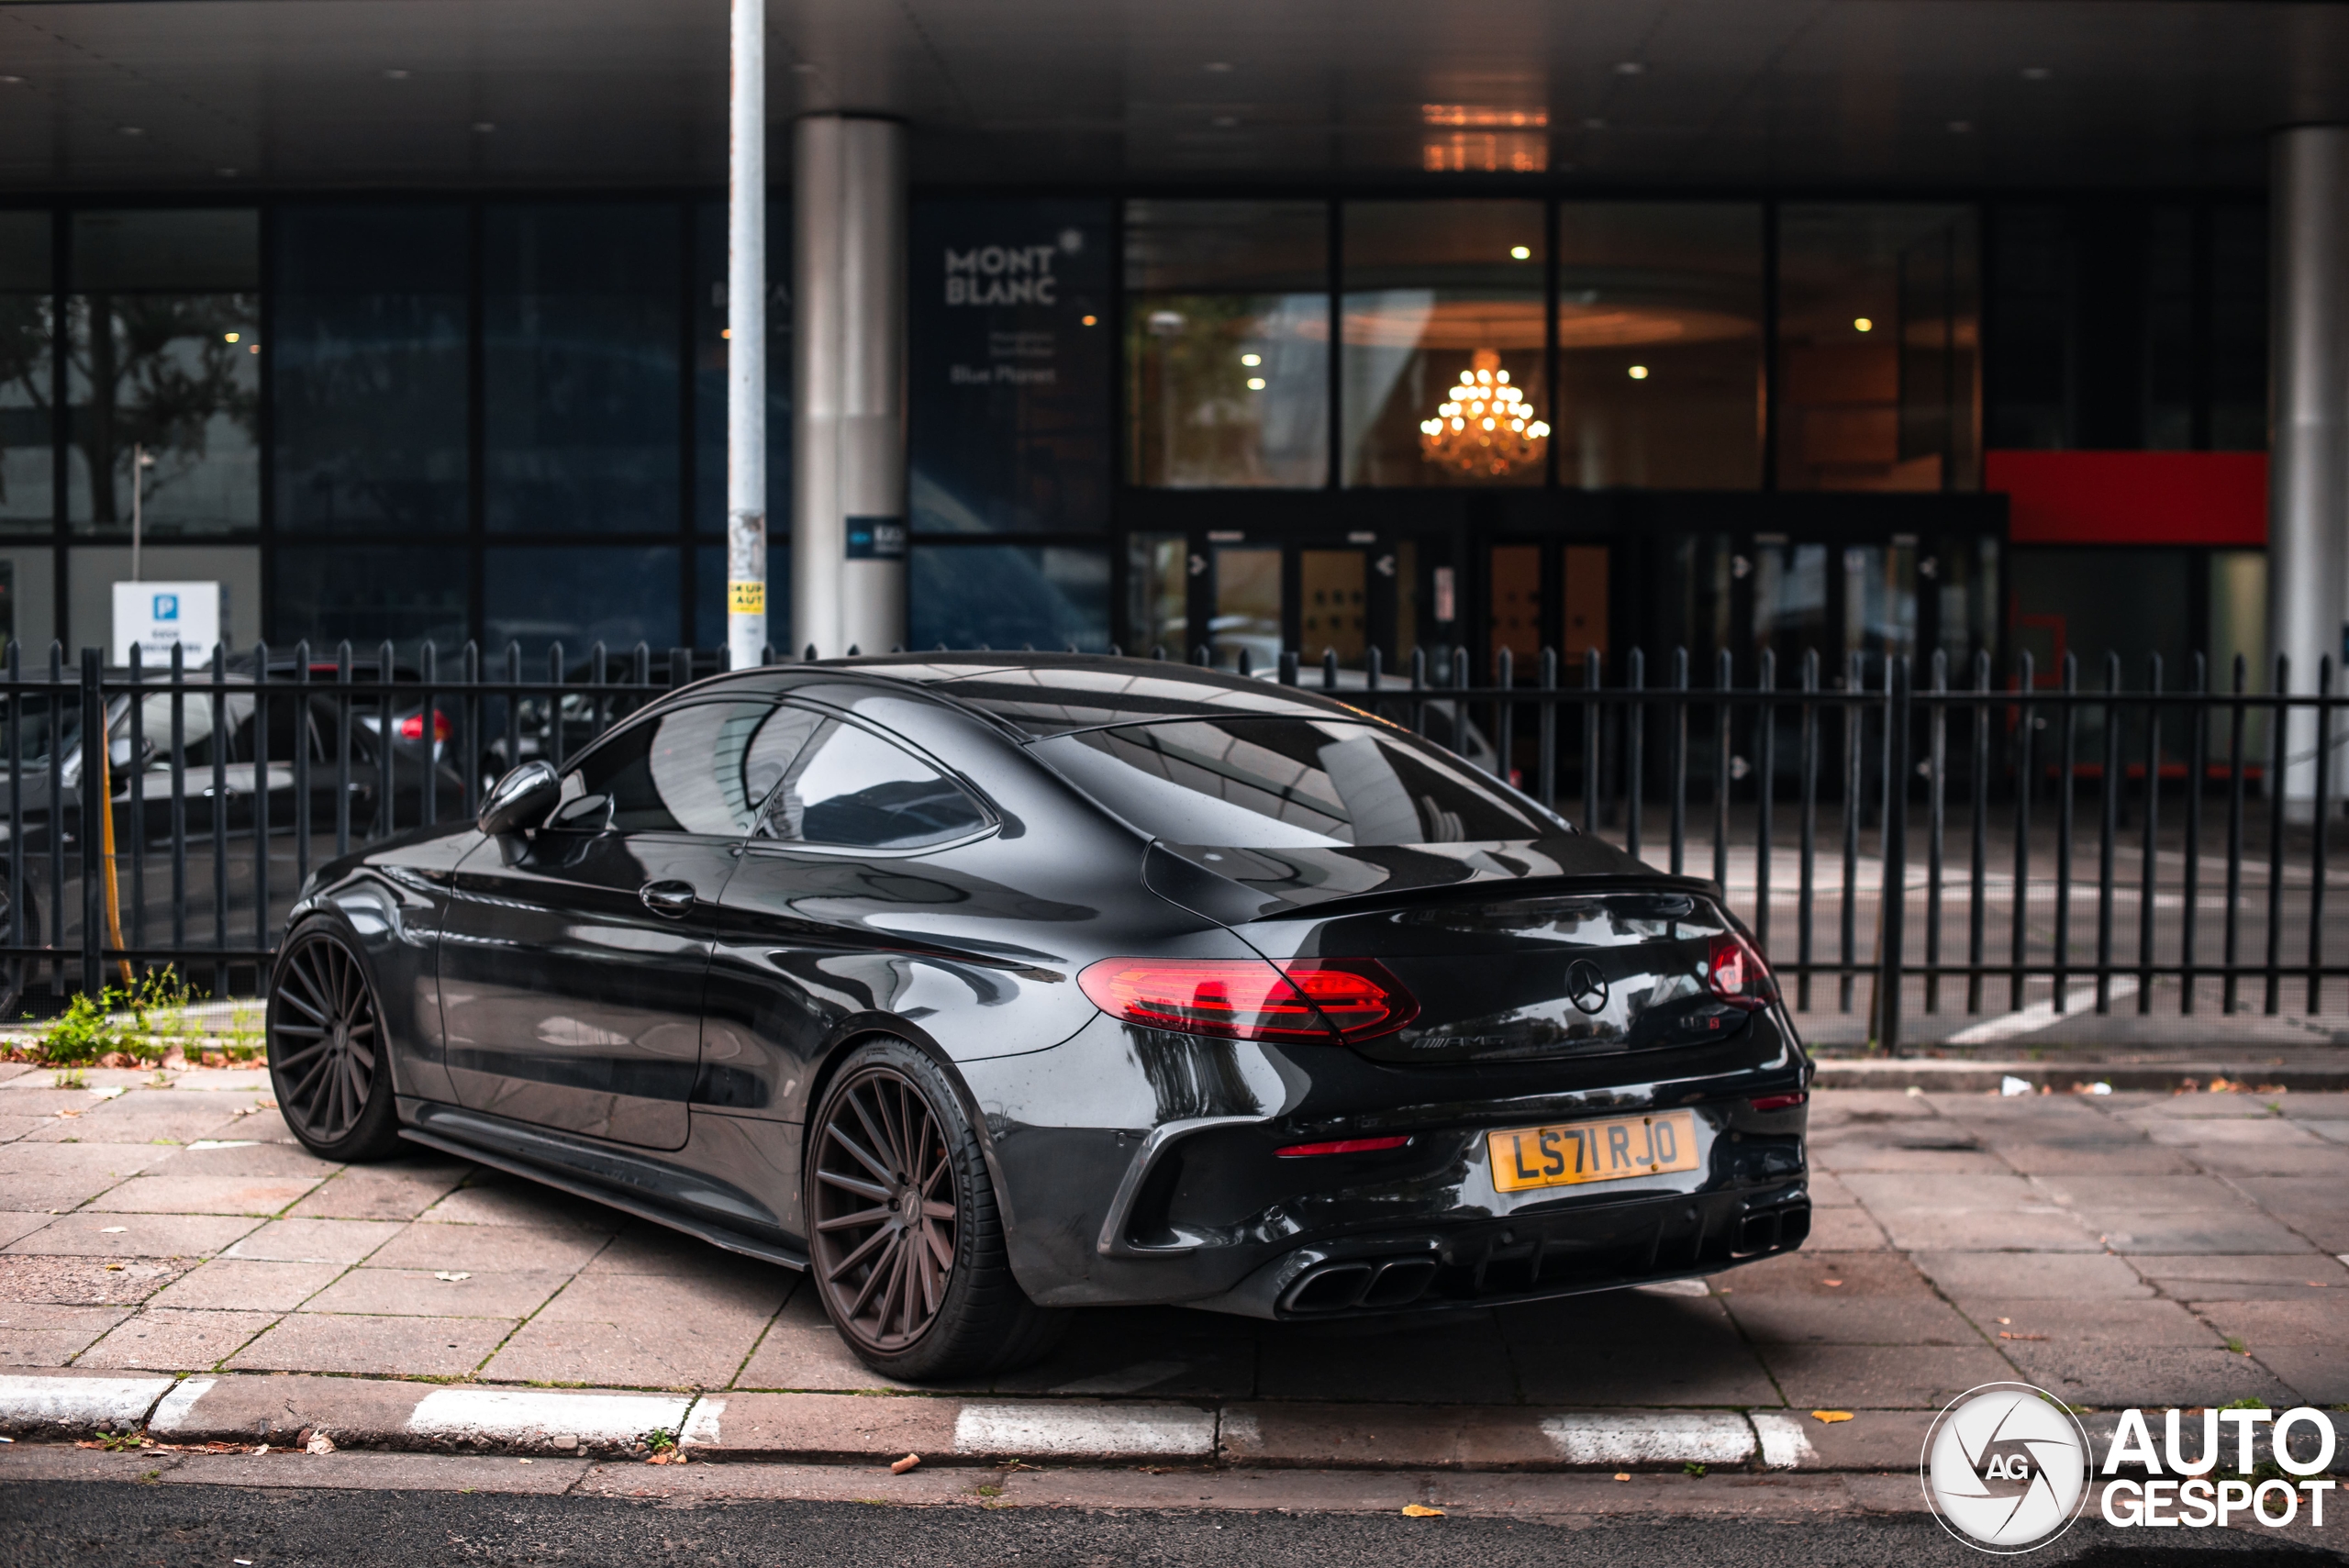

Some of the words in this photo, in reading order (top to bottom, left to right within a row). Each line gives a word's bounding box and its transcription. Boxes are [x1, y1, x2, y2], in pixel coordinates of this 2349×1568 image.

[945, 246, 1055, 274] MONT
[945, 277, 1056, 306] BLANC
[1512, 1128, 1600, 1180] LS71
[1608, 1120, 1678, 1170] RJO
[962, 1173, 974, 1267] MICHELIN
